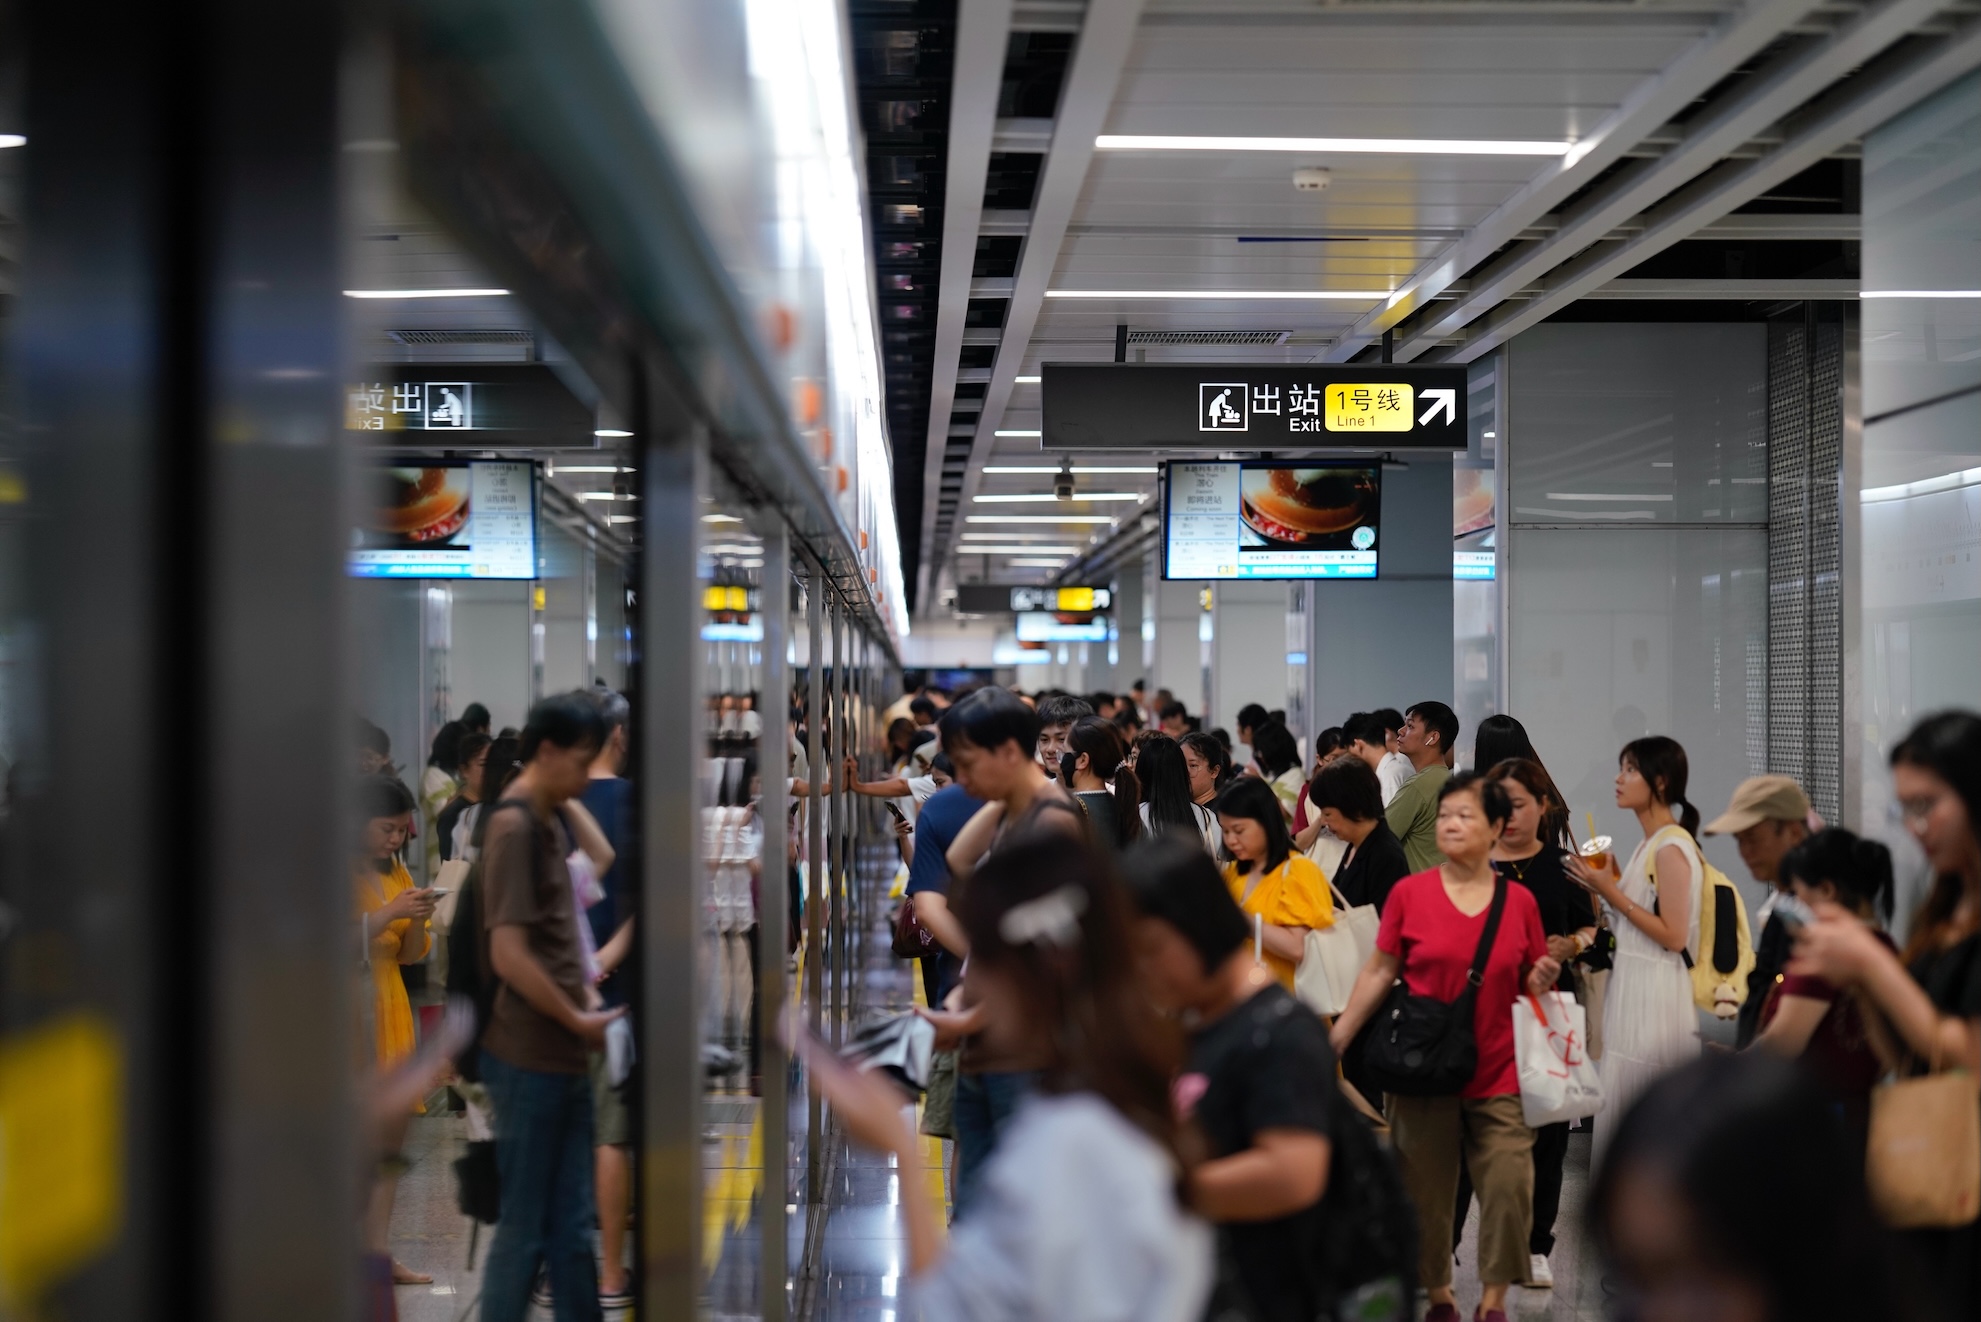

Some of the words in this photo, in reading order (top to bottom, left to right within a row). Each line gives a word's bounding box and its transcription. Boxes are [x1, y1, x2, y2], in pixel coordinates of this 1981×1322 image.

[1252, 383, 1321, 416] 出站
[1337, 389, 1401, 411] 1号线
[1289, 418, 1321, 432] Exit
[1337, 415, 1365, 427] Line
[1369, 415, 1375, 426] 1
